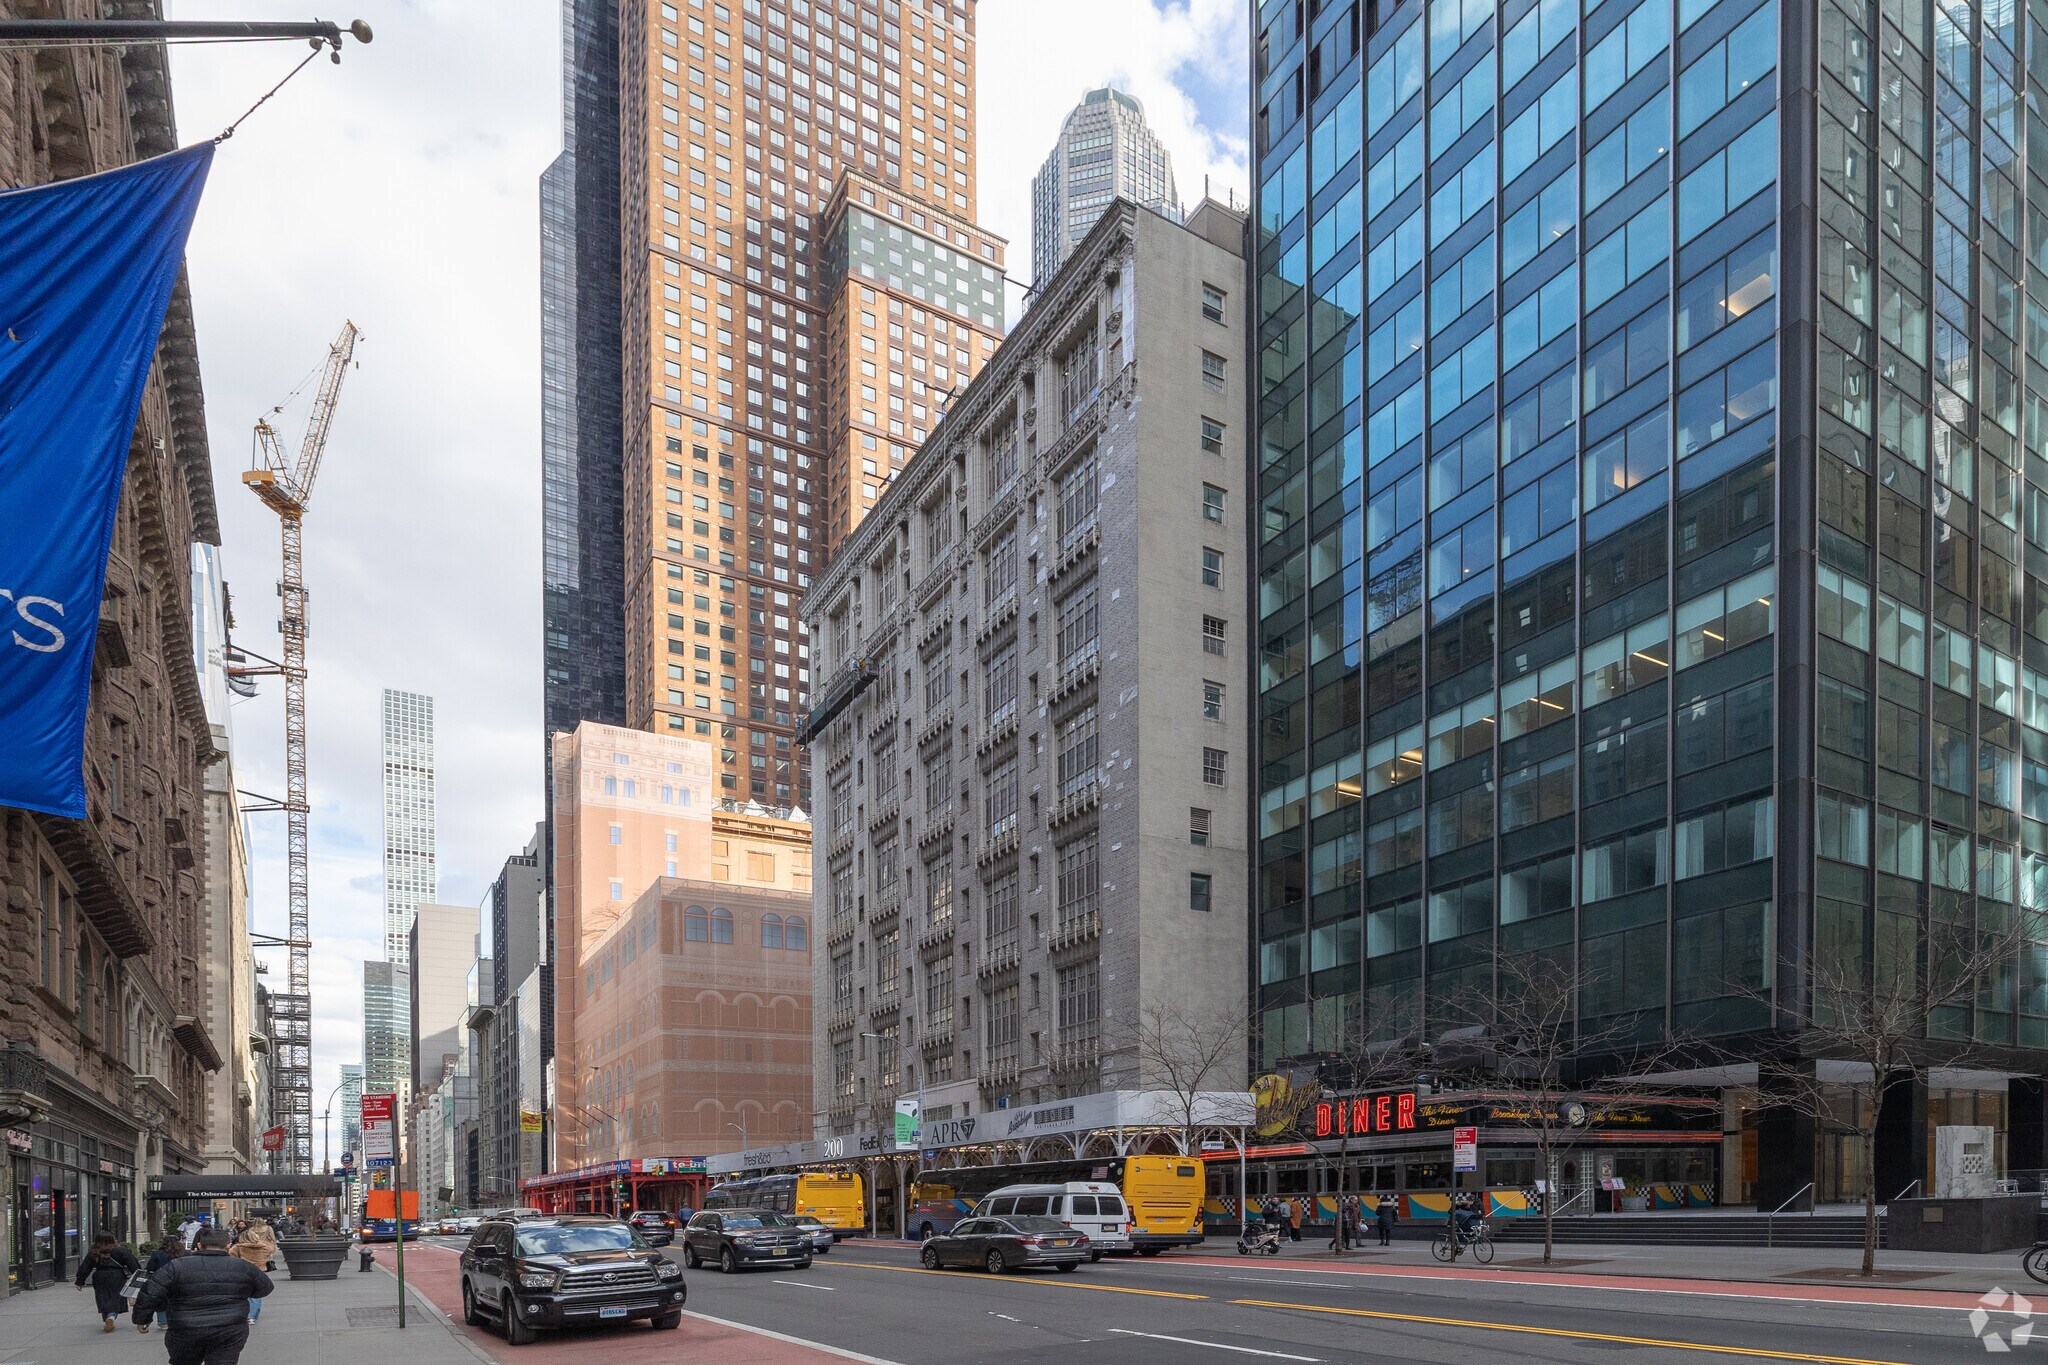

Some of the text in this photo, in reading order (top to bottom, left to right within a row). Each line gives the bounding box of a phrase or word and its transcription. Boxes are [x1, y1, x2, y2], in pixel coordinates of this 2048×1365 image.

[1316, 1093, 1416, 1137] DINER
[1419, 1104, 1465, 1116] The Finer
[1491, 1106, 1530, 1119] Brooklyn
[1427, 1117, 1457, 1127] Diner
[1629, 1113, 1651, 1122] Diner
[366, 1122, 373, 1130] 3
[930, 1121, 961, 1145] APR
[824, 1138, 843, 1158] 200
[859, 1133, 895, 1151] FedEx Off
[743, 1152, 772, 1166] fresh&co
